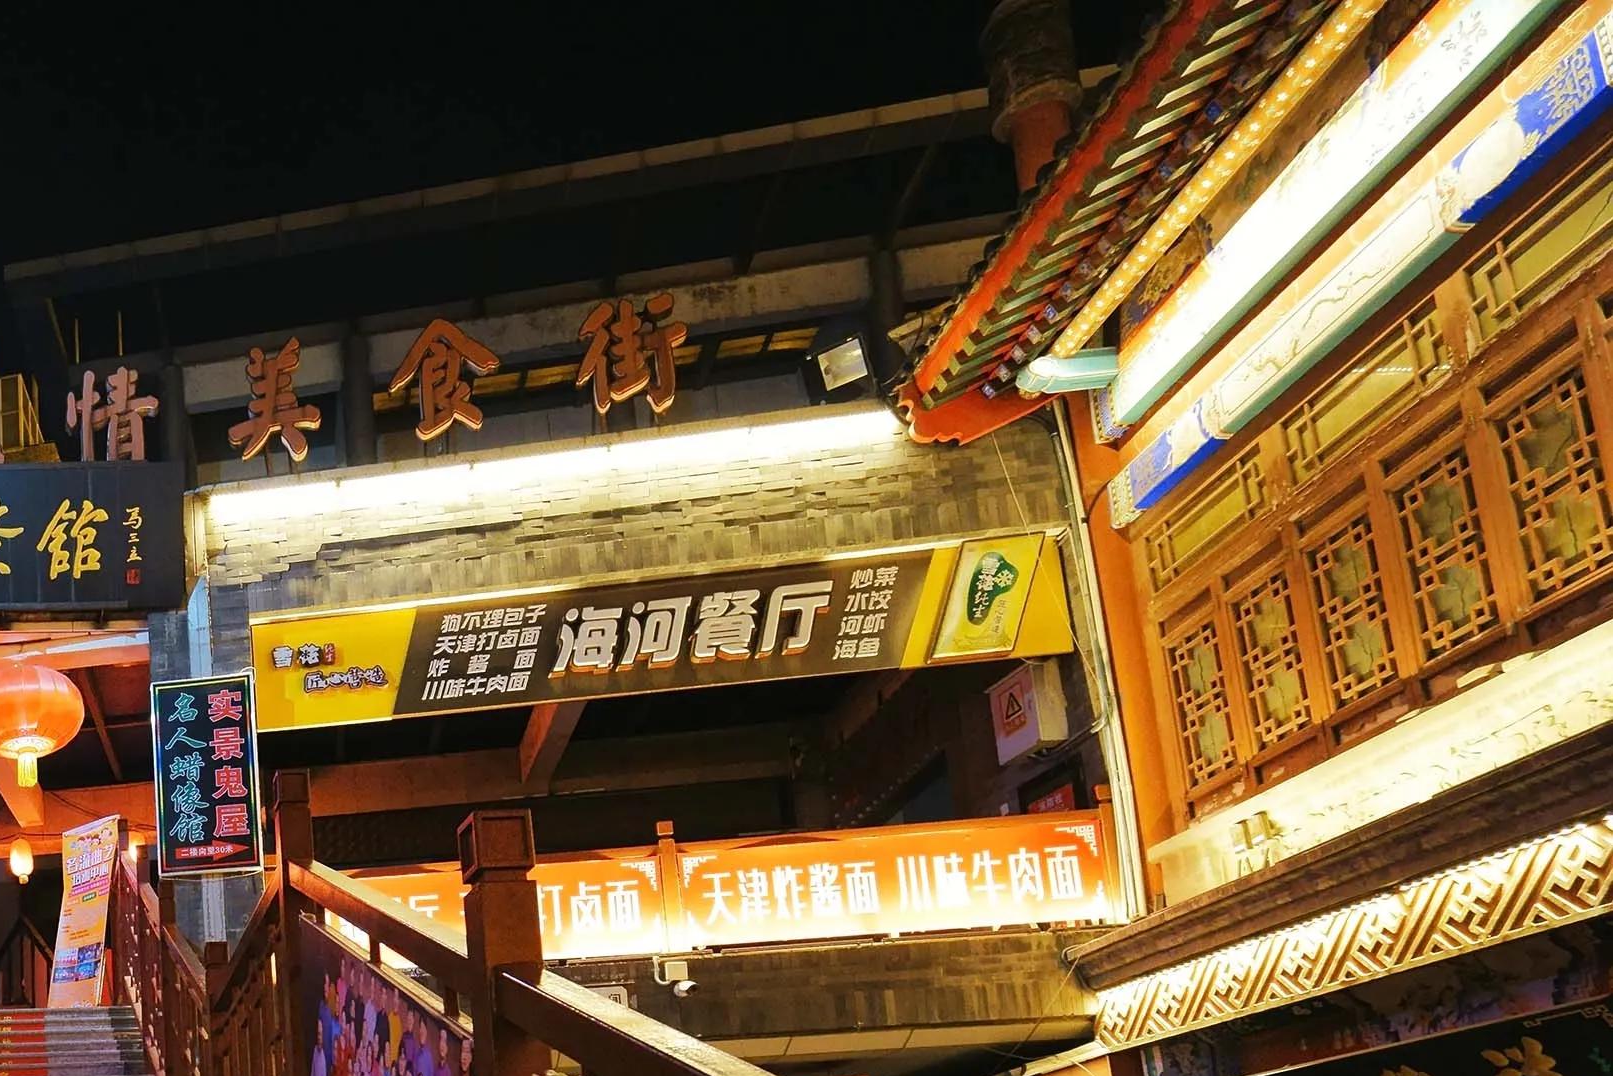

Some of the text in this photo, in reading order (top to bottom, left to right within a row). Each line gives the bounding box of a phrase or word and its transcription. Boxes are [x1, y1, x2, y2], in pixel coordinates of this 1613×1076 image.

[850, 566, 899, 589] 炒菜
[844, 589, 893, 612] 水饺
[441, 604, 547, 632] 狗不理包子
[548, 580, 834, 679] 海河餐厅
[838, 612, 888, 636] 河虾
[435, 626, 542, 655] 天津打卤面
[832, 637, 880, 660] 海鱼
[421, 671, 531, 700] 川味牛肉面
[165, 692, 210, 843] 名人蜡像馆
[207, 689, 250, 838] 实景鬼屋
[699, 845, 1085, 926] 天津炸酱面 川味牛肉面
